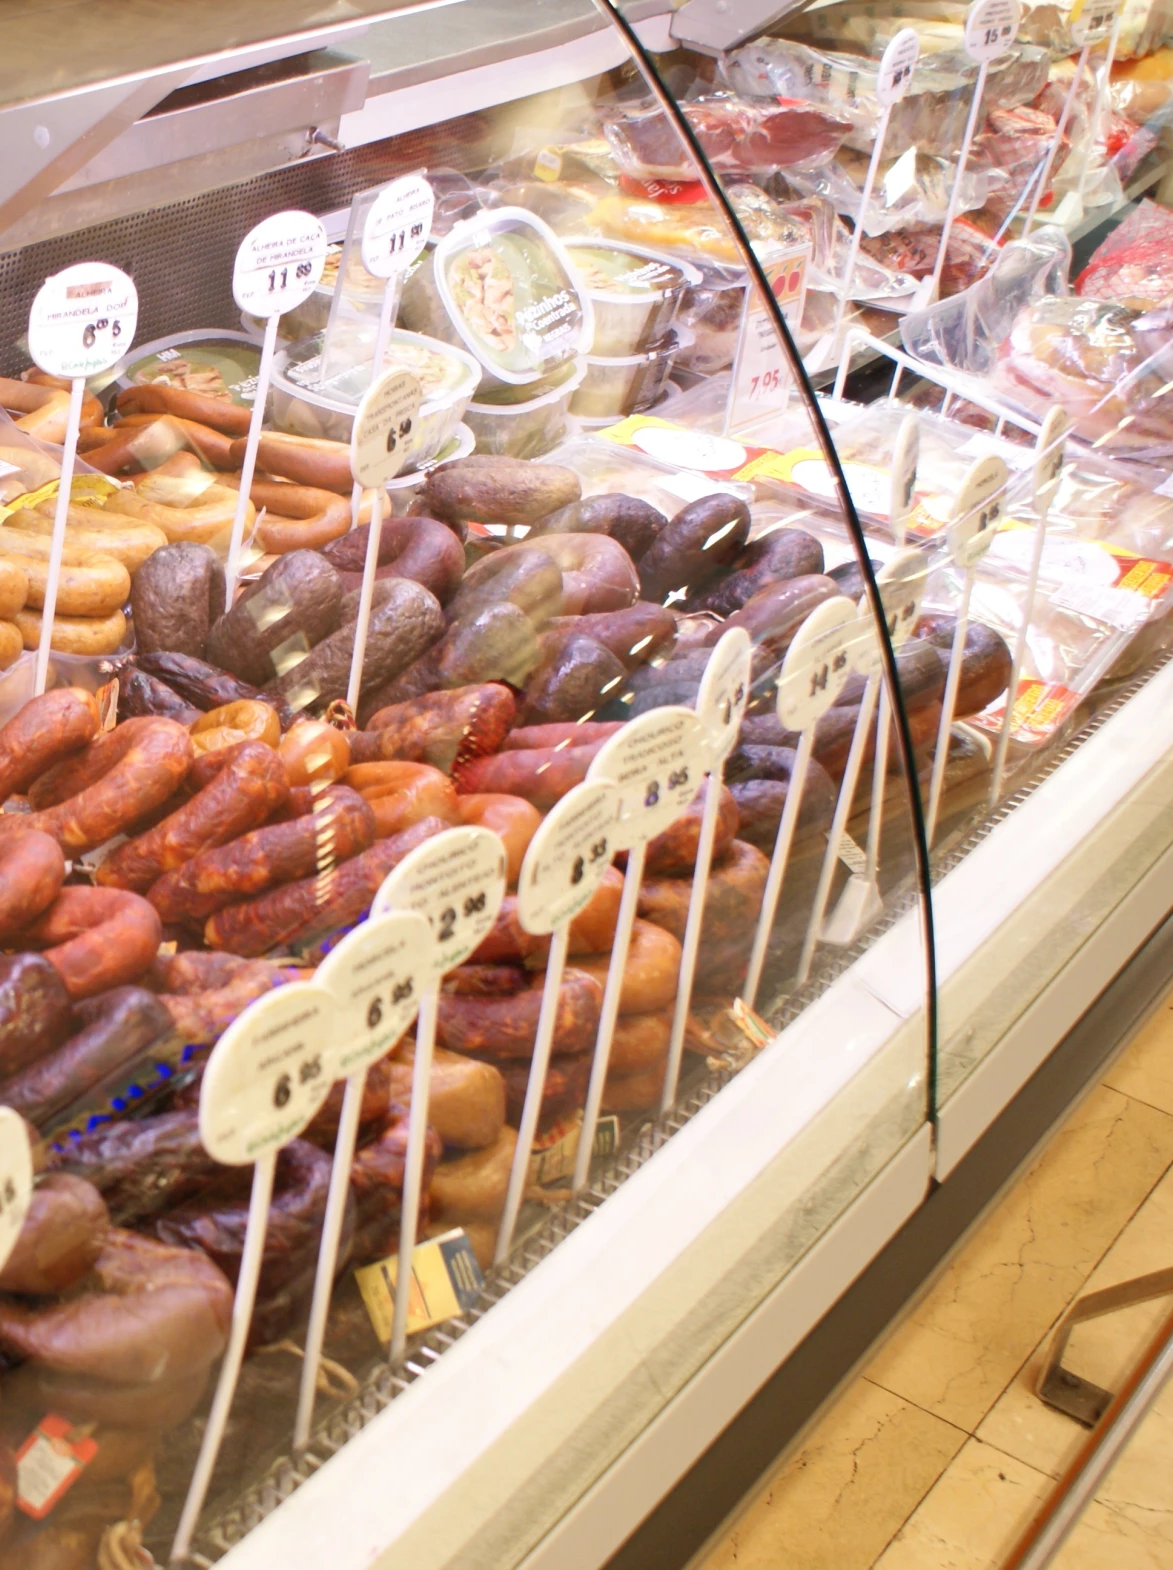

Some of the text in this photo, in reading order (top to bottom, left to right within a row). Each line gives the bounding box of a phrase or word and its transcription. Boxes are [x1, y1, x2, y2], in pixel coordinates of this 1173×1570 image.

[252, 240, 283, 252] ALHEIRA
[286, 237, 297, 247] DE
[256, 247, 314, 265] DE MIRANDELA
[268, 266, 288, 292] 11
[47, 307, 99, 321] MIRANDELA
